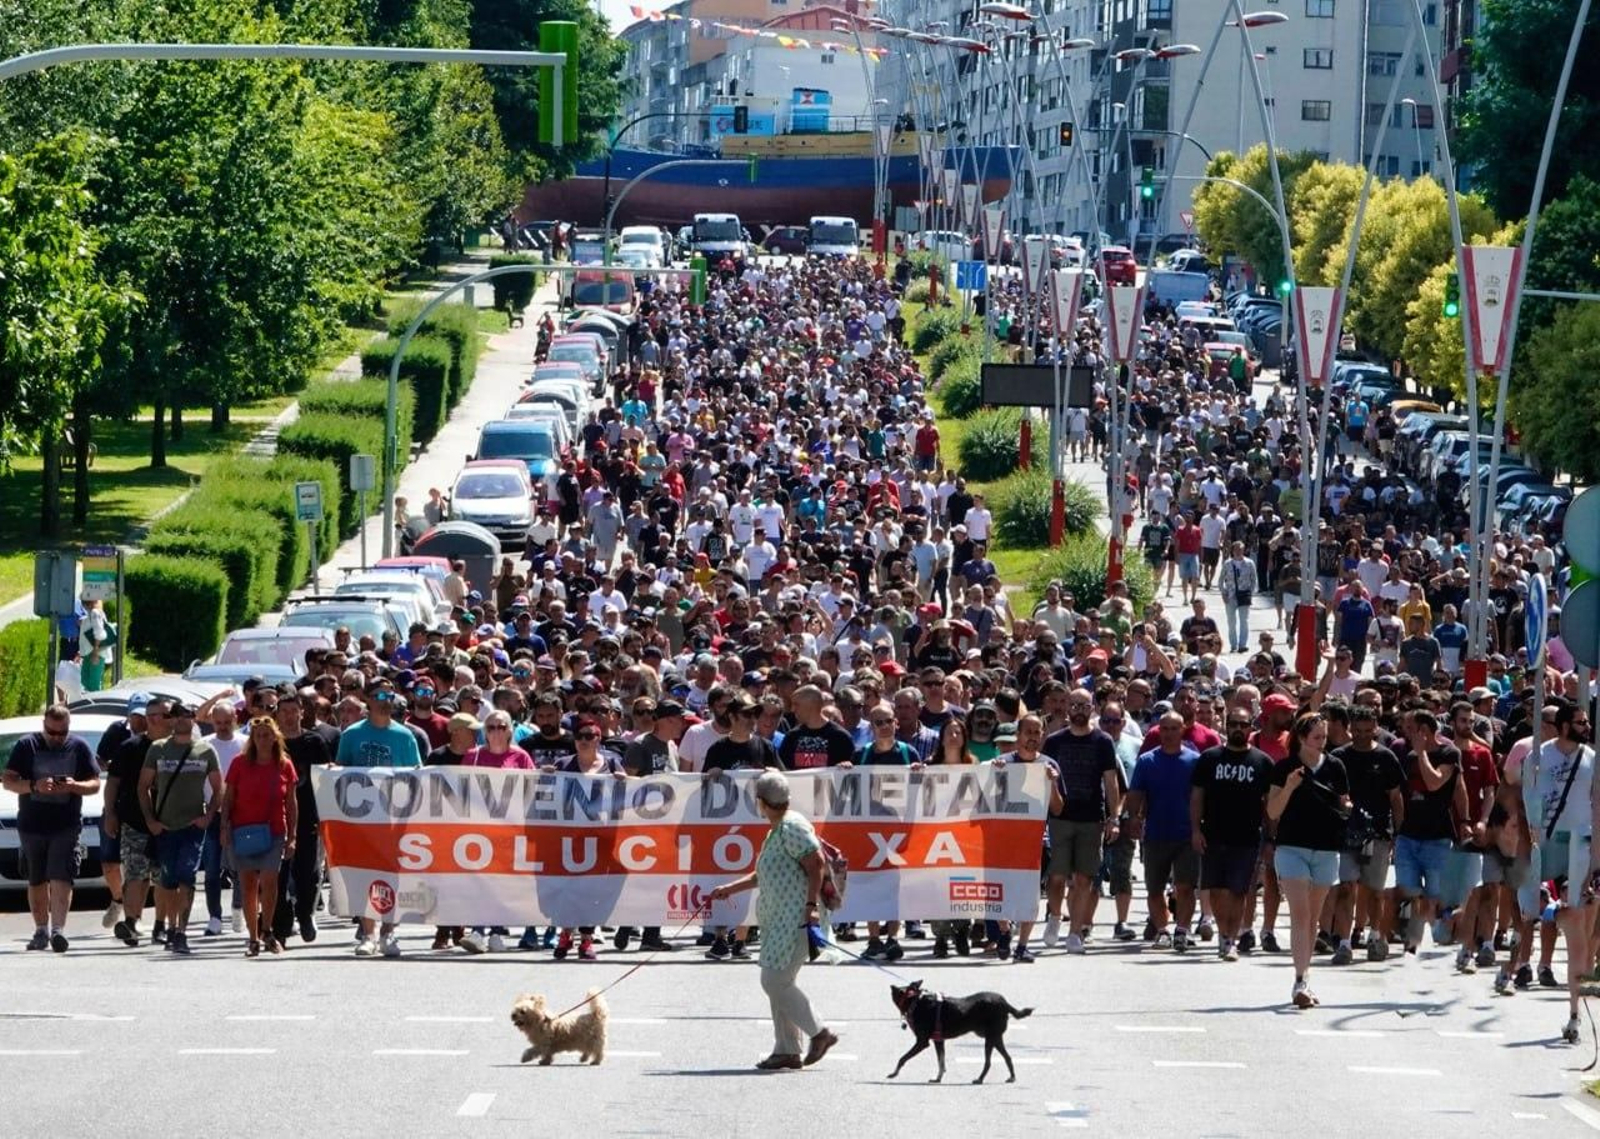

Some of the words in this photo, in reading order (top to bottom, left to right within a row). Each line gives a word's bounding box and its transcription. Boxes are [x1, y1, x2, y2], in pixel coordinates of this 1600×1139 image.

[333, 771, 676, 821] CONVENIO
[813, 770, 1030, 819] METAL
[397, 825, 754, 871] SOLUCIÓ
[867, 831, 967, 868] XA
[667, 883, 713, 911] CIG
[952, 884, 1001, 898] CCOO
[950, 900, 1002, 914] industria
